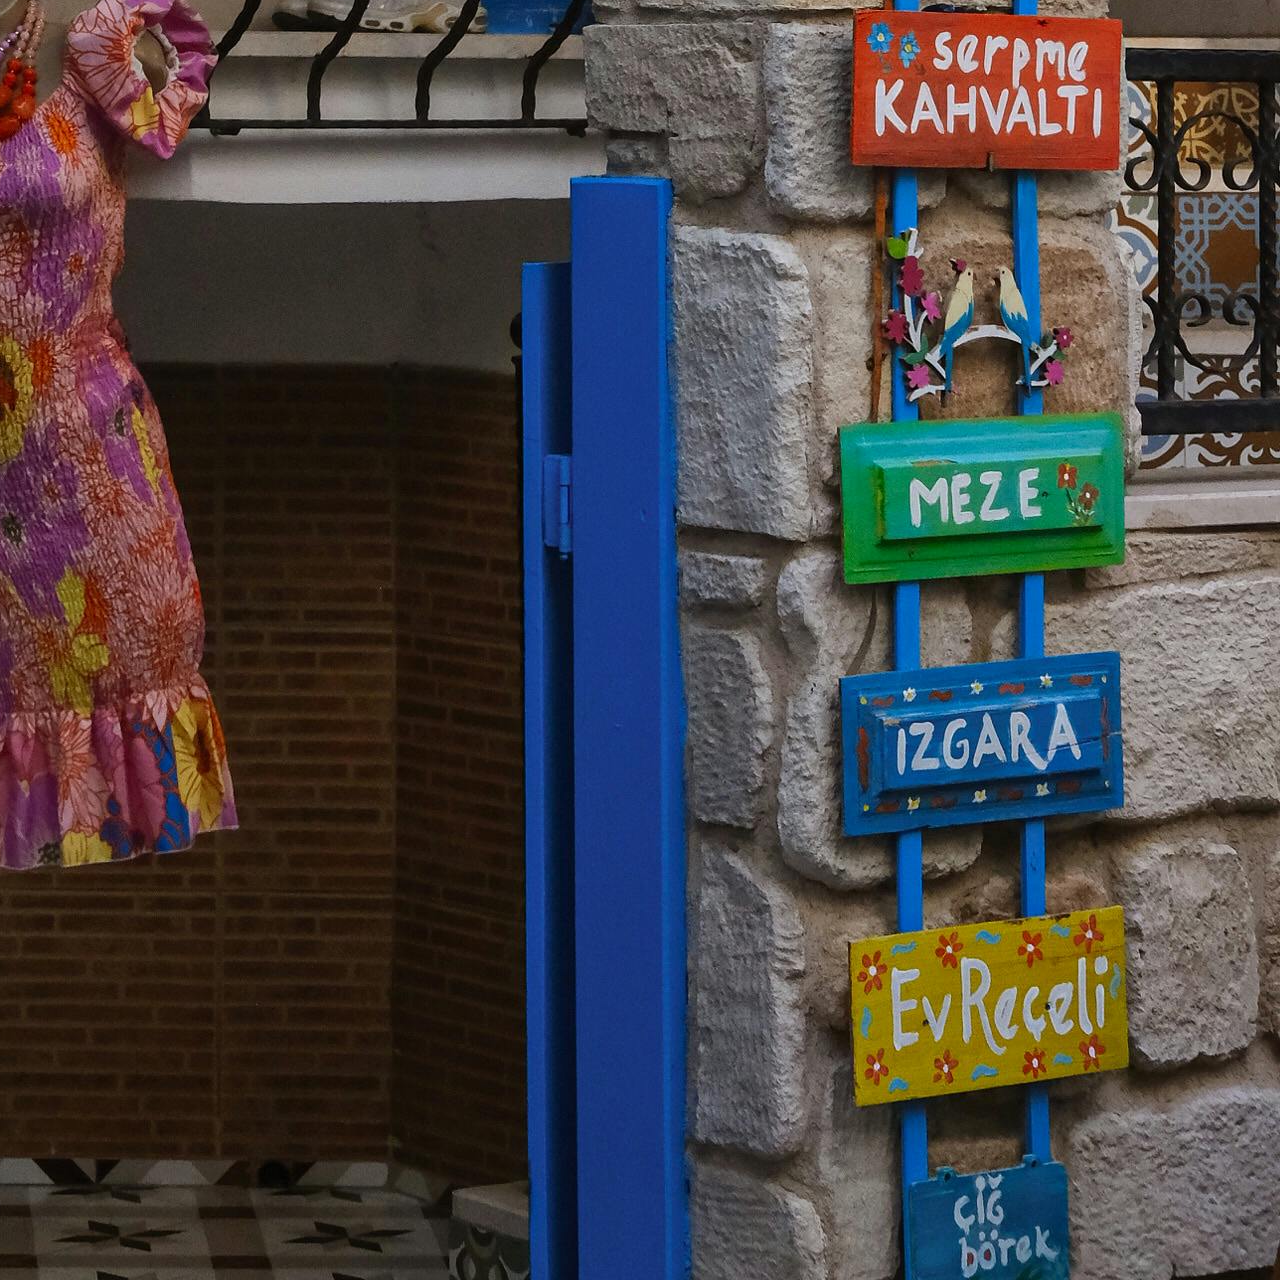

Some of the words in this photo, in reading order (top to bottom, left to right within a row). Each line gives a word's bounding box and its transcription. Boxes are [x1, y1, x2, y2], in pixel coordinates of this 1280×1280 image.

[933, 31, 1088, 89] serpme
[875, 79, 1101, 139] KAHVALTI
[909, 468, 1042, 528] MEZE
[897, 703, 1081, 774] IZGARA
[961, 956, 1108, 1055] Reçeli
[959, 1228, 1060, 1278] börek
